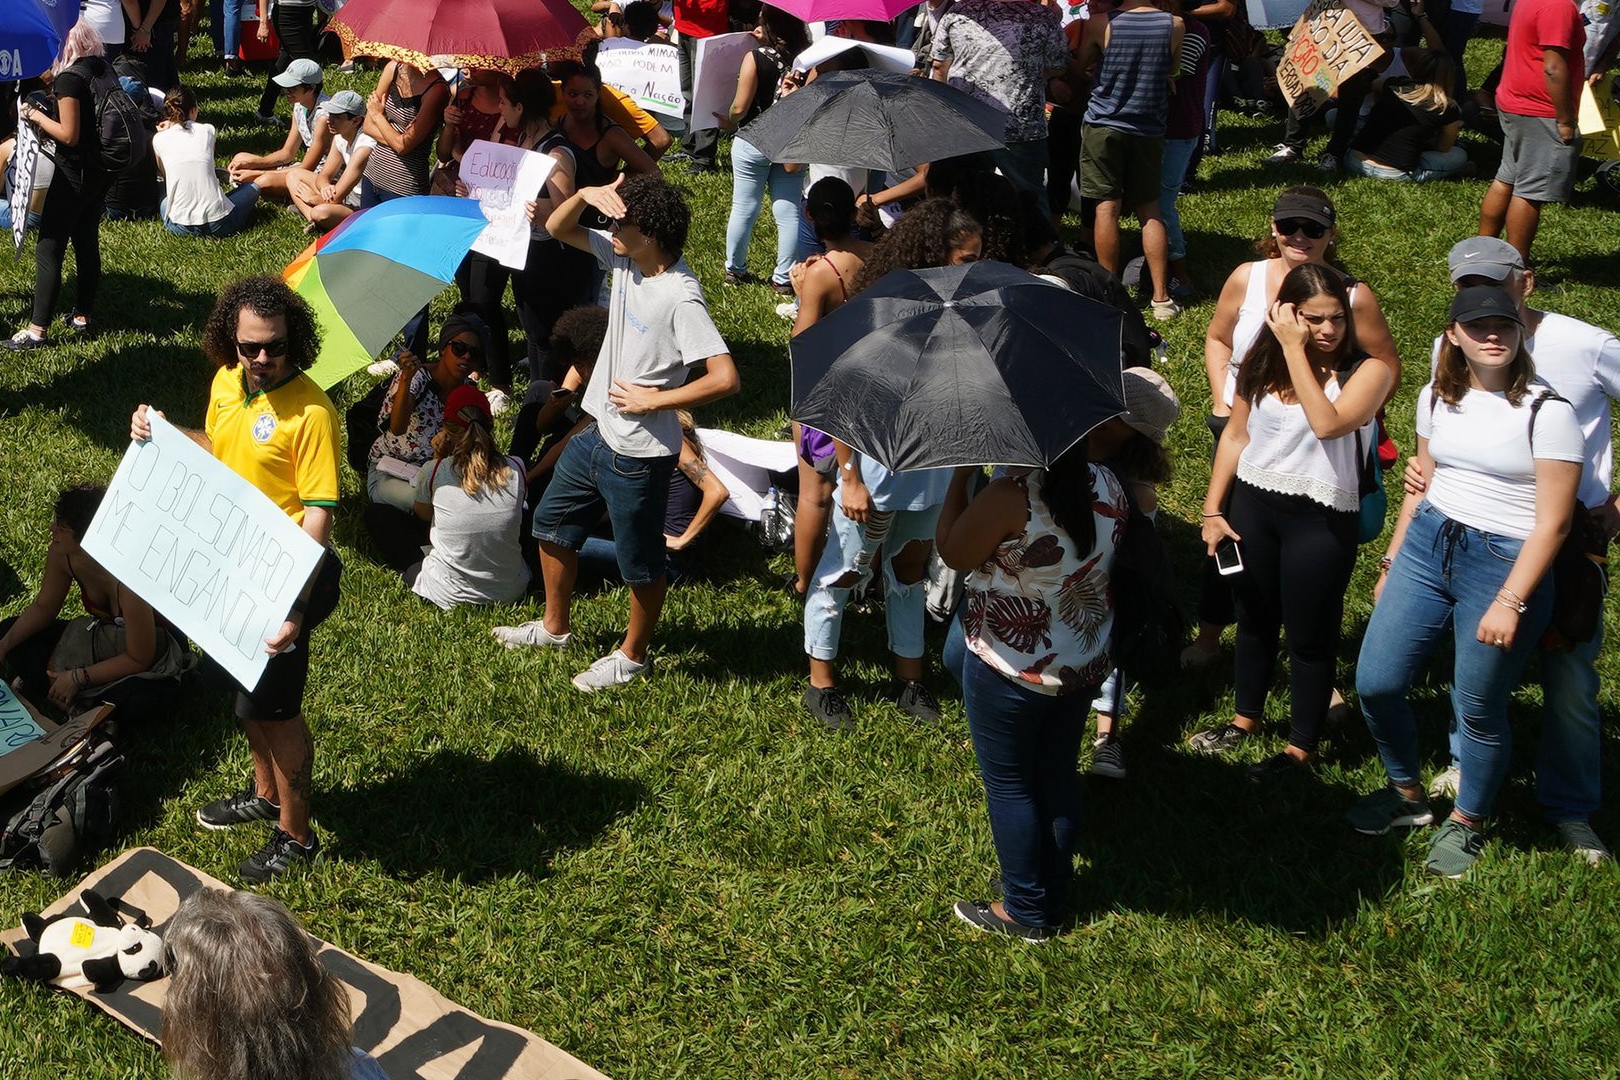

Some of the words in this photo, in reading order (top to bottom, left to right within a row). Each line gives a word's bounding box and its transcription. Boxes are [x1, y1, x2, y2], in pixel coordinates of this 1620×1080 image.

[1322, 40, 1349, 80] DIA
[1337, 20, 1374, 63] LUTA
[633, 60, 674, 74] PODEM
[642, 80, 681, 104] Nação
[128, 441, 160, 492] O
[156, 461, 295, 603] BOLSONARO
[97, 489, 146, 557] ME
[139, 524, 271, 661] ENGANOU
